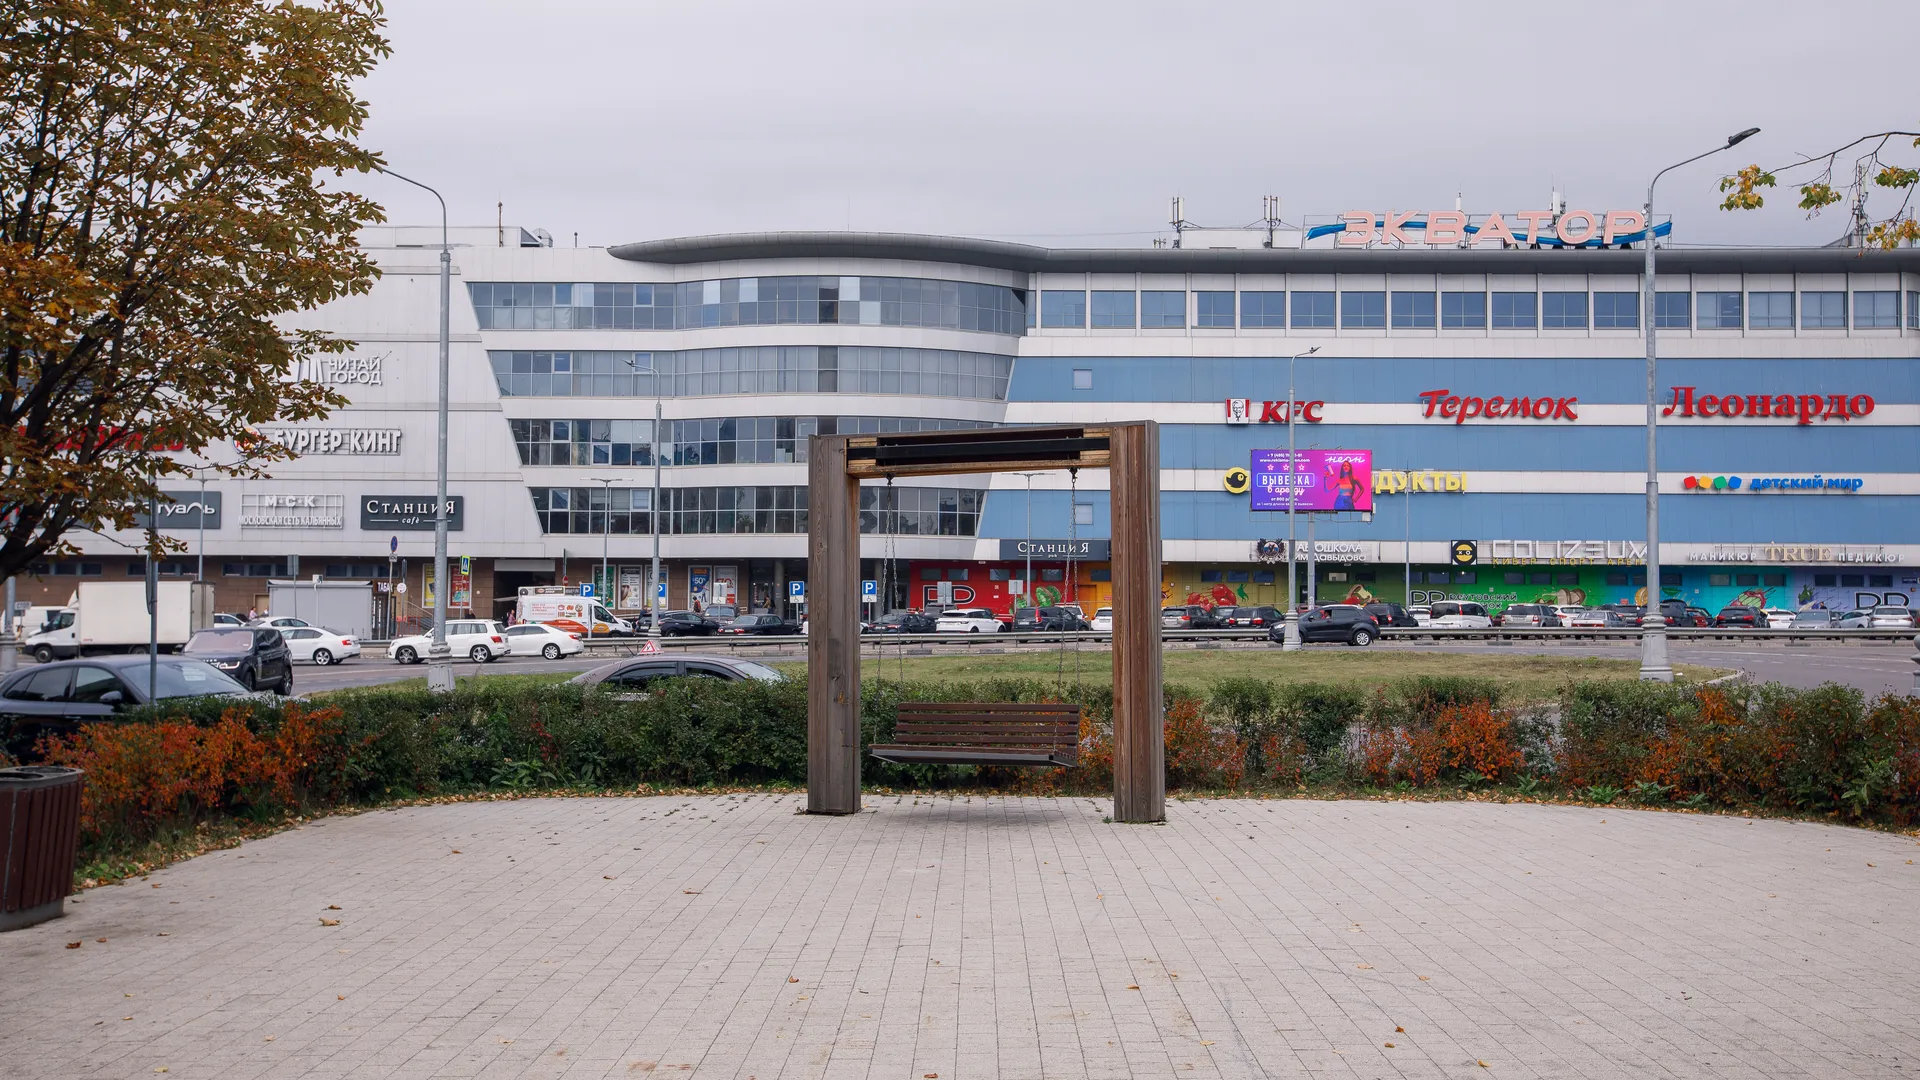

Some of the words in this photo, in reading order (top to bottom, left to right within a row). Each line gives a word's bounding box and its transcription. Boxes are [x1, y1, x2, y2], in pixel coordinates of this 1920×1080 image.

[1340, 210, 1646, 245] ЭКВАТОР
[328, 356, 382, 371] ЧИТАЙ
[328, 371, 382, 386] ГОРОД
[1259, 401, 1324, 423] KFC
[1419, 389, 1579, 425] Теремок
[1662, 386, 1876, 425] Леонардо
[274, 430, 342, 453] БУРГЕР
[350, 430, 402, 453] КИНГ
[1262, 475, 1310, 485] ВЫВЕКА
[1372, 472, 1467, 494] ДУКТЫ
[1750, 475, 1823, 490] детский
[1827, 477, 1863, 492] мир
[1275, 486, 1306, 496] ареду
[1492, 558, 1538, 566] КИБЕР
[1550, 558, 1595, 566] СПОРТ
[1607, 558, 1648, 566] АРЕН
[1689, 552, 1757, 562] МАНИКЮР
[1764, 545, 1833, 562] TRUE
[1838, 552, 1905, 563] ПЕДИКЮР
